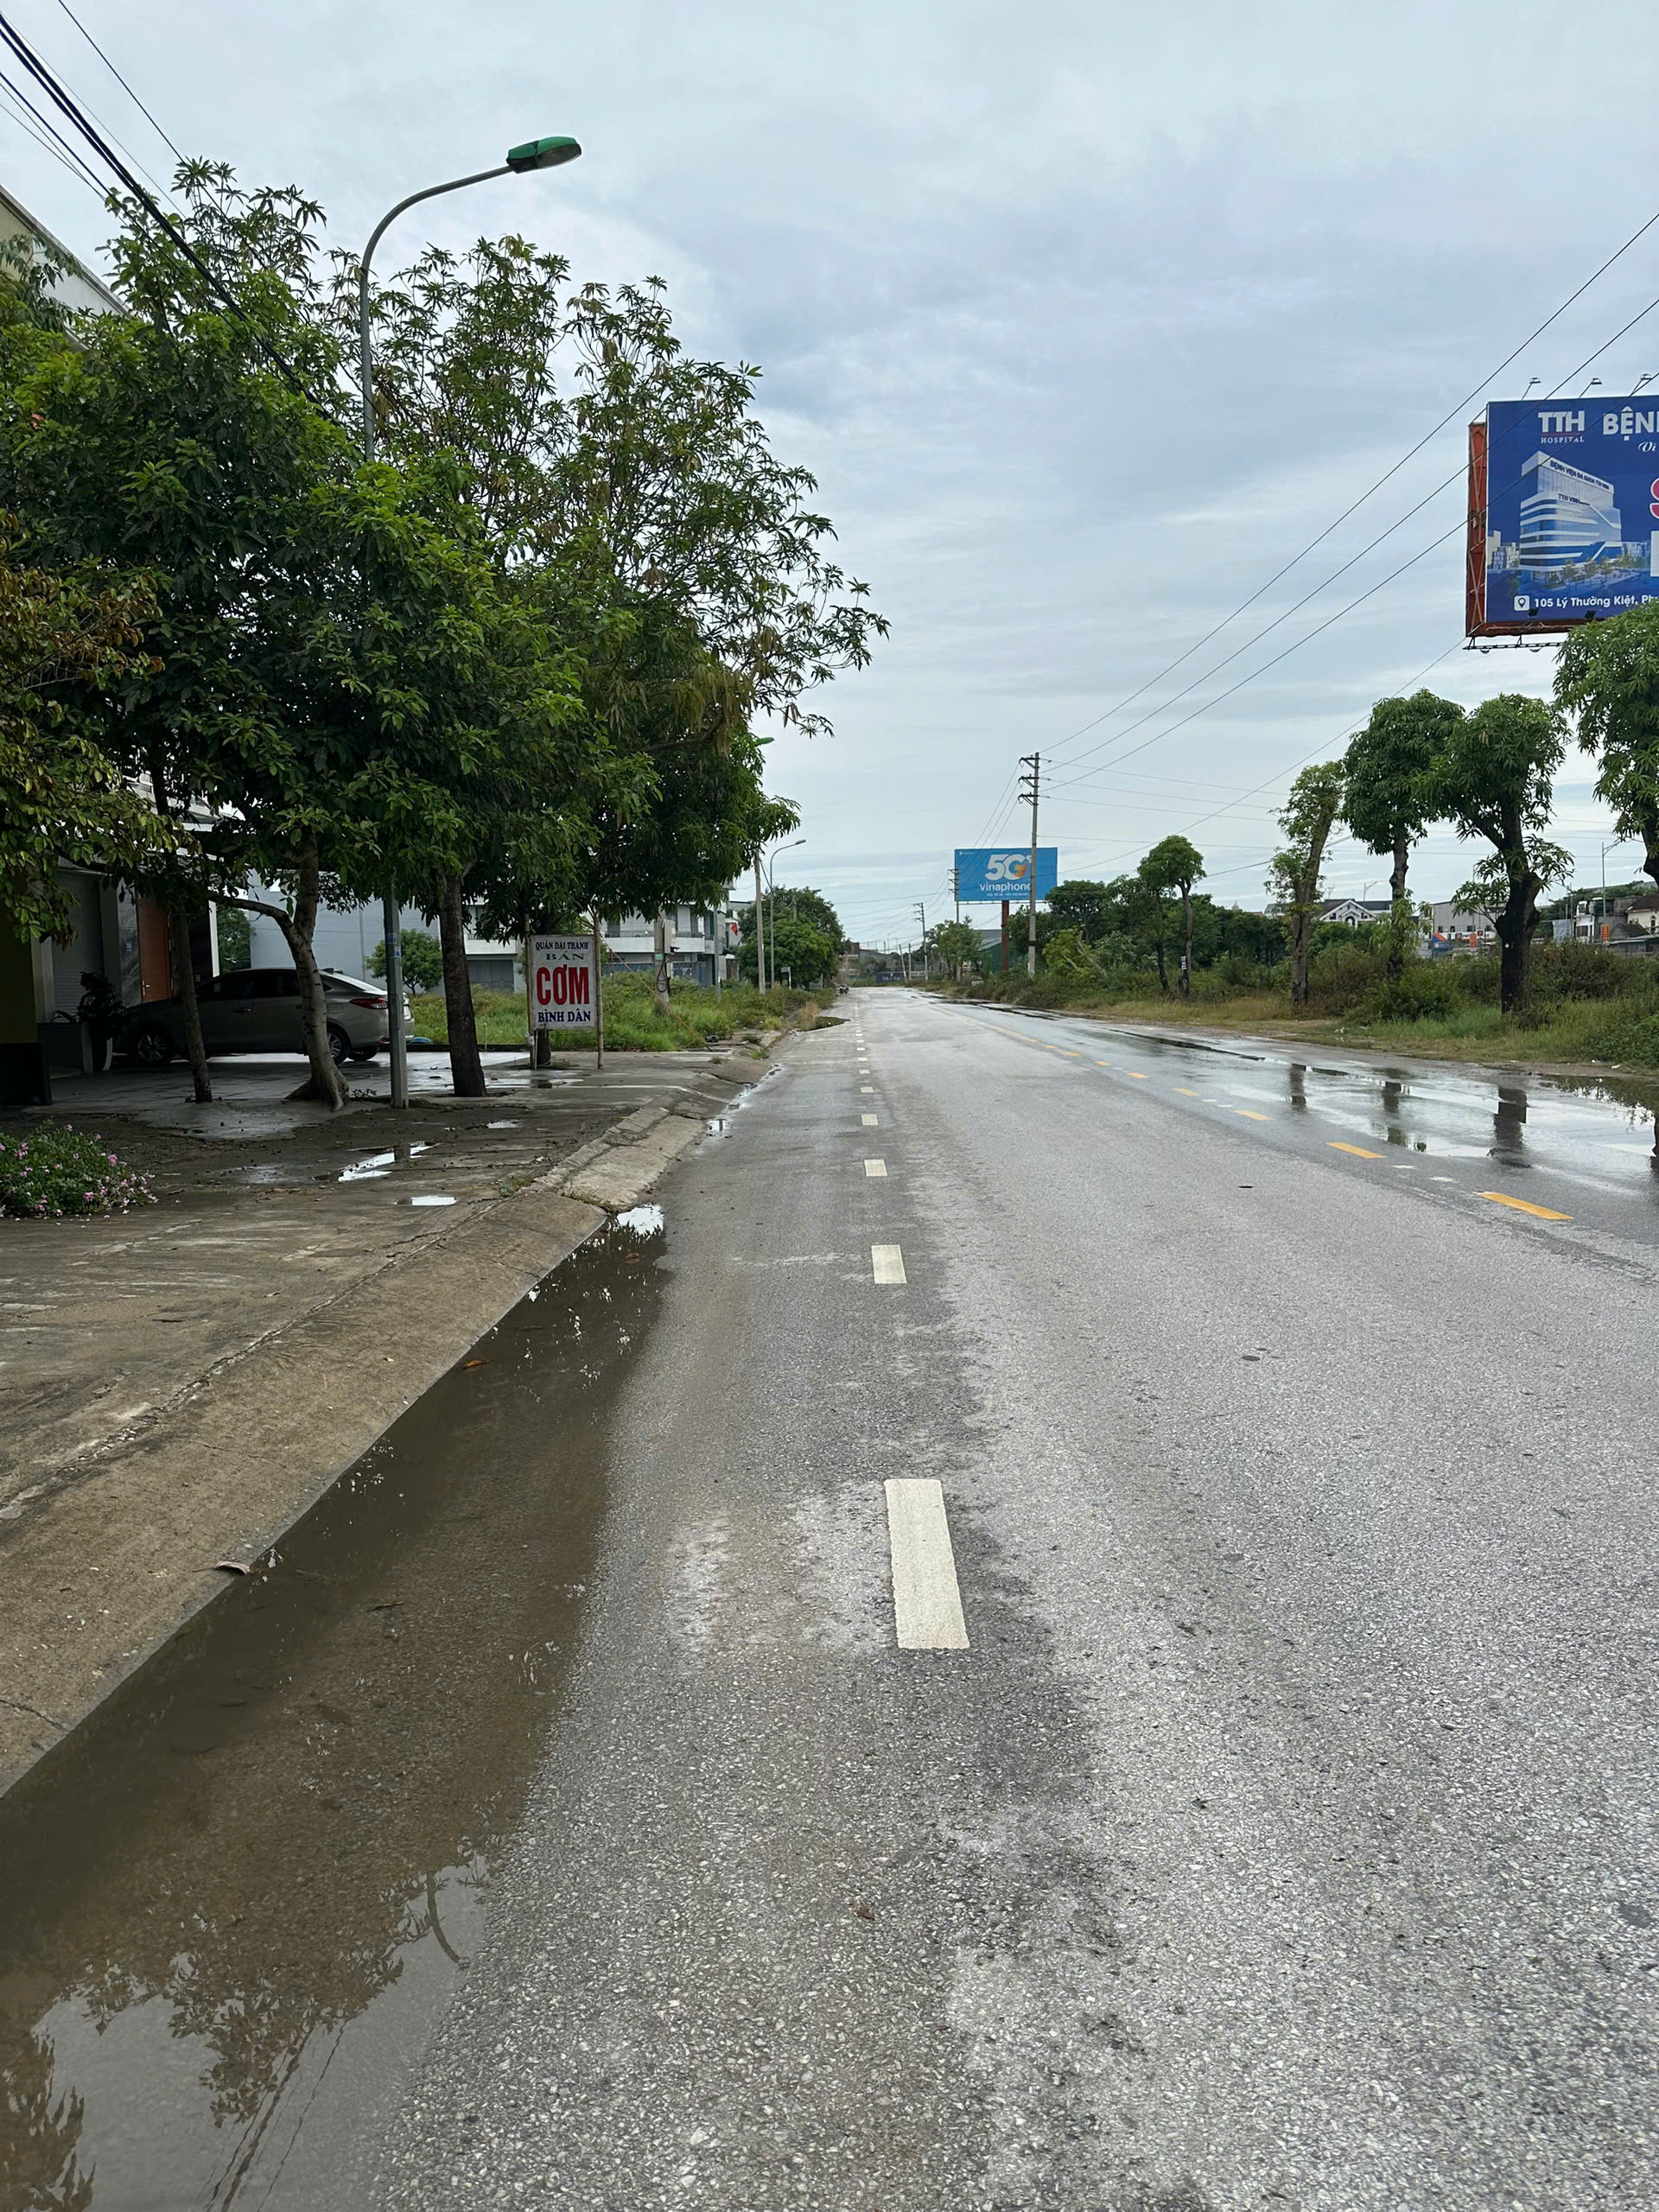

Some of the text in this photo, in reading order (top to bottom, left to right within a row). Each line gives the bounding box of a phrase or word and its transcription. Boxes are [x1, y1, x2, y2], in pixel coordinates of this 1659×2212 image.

[1538, 410, 1585, 433] TTH
[1603, 406, 1659, 441] BỆN
[1535, 598, 1554, 607] 105
[1556, 597, 1568, 608] Lý
[1571, 595, 1611, 607] Thường
[536, 939, 553, 950] QUÁN
[567, 939, 588, 950] THÀNH
[546, 950, 584, 960] BÁN
[536, 964, 589, 1006] CƠM
[537, 1008, 591, 1022] BÌNH DÂN
